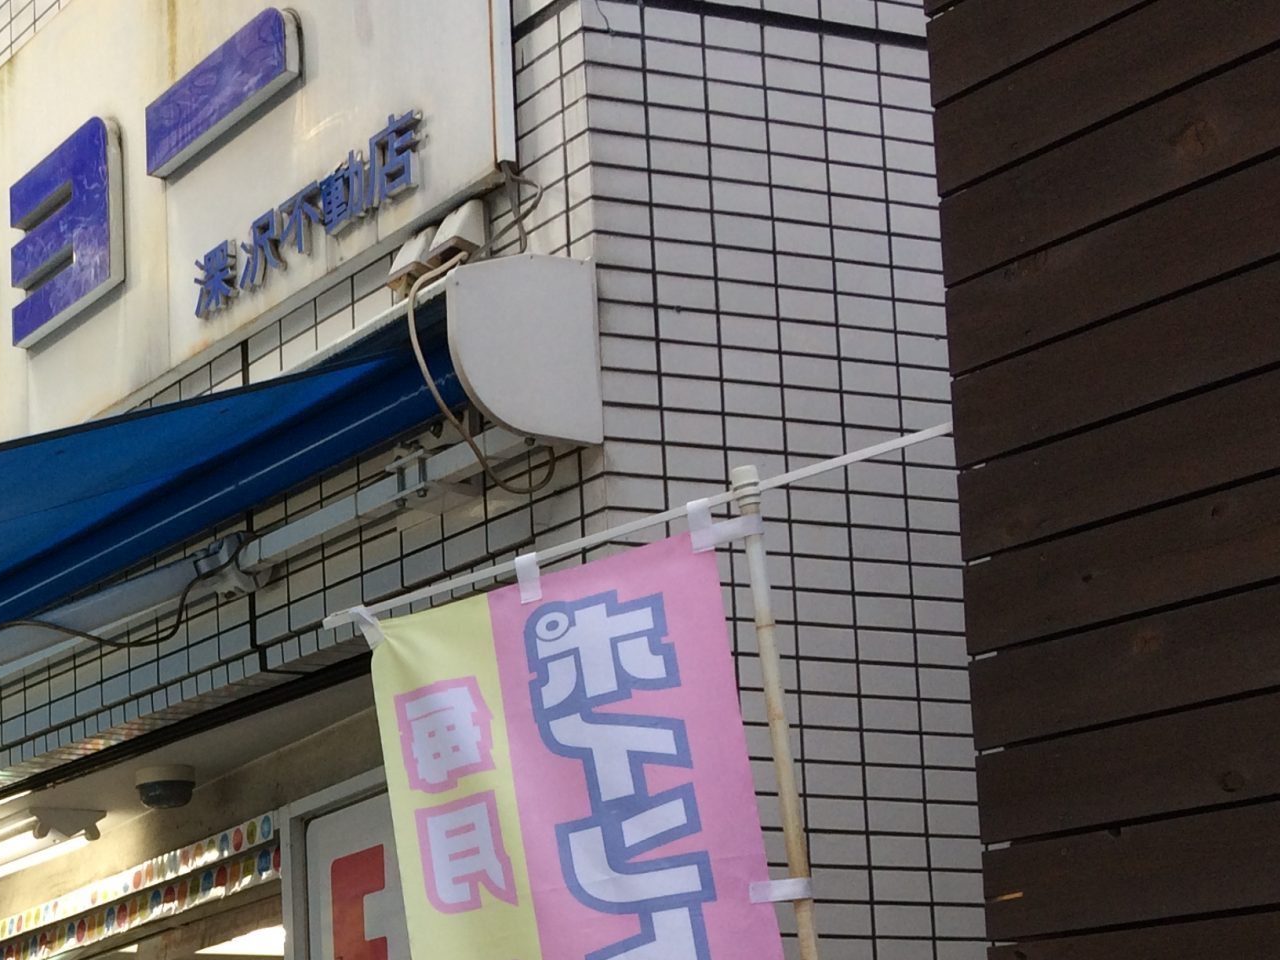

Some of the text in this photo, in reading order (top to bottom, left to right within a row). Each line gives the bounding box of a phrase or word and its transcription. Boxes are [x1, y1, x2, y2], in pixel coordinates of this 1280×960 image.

[195, 108, 422, 320] 深沢不動店
